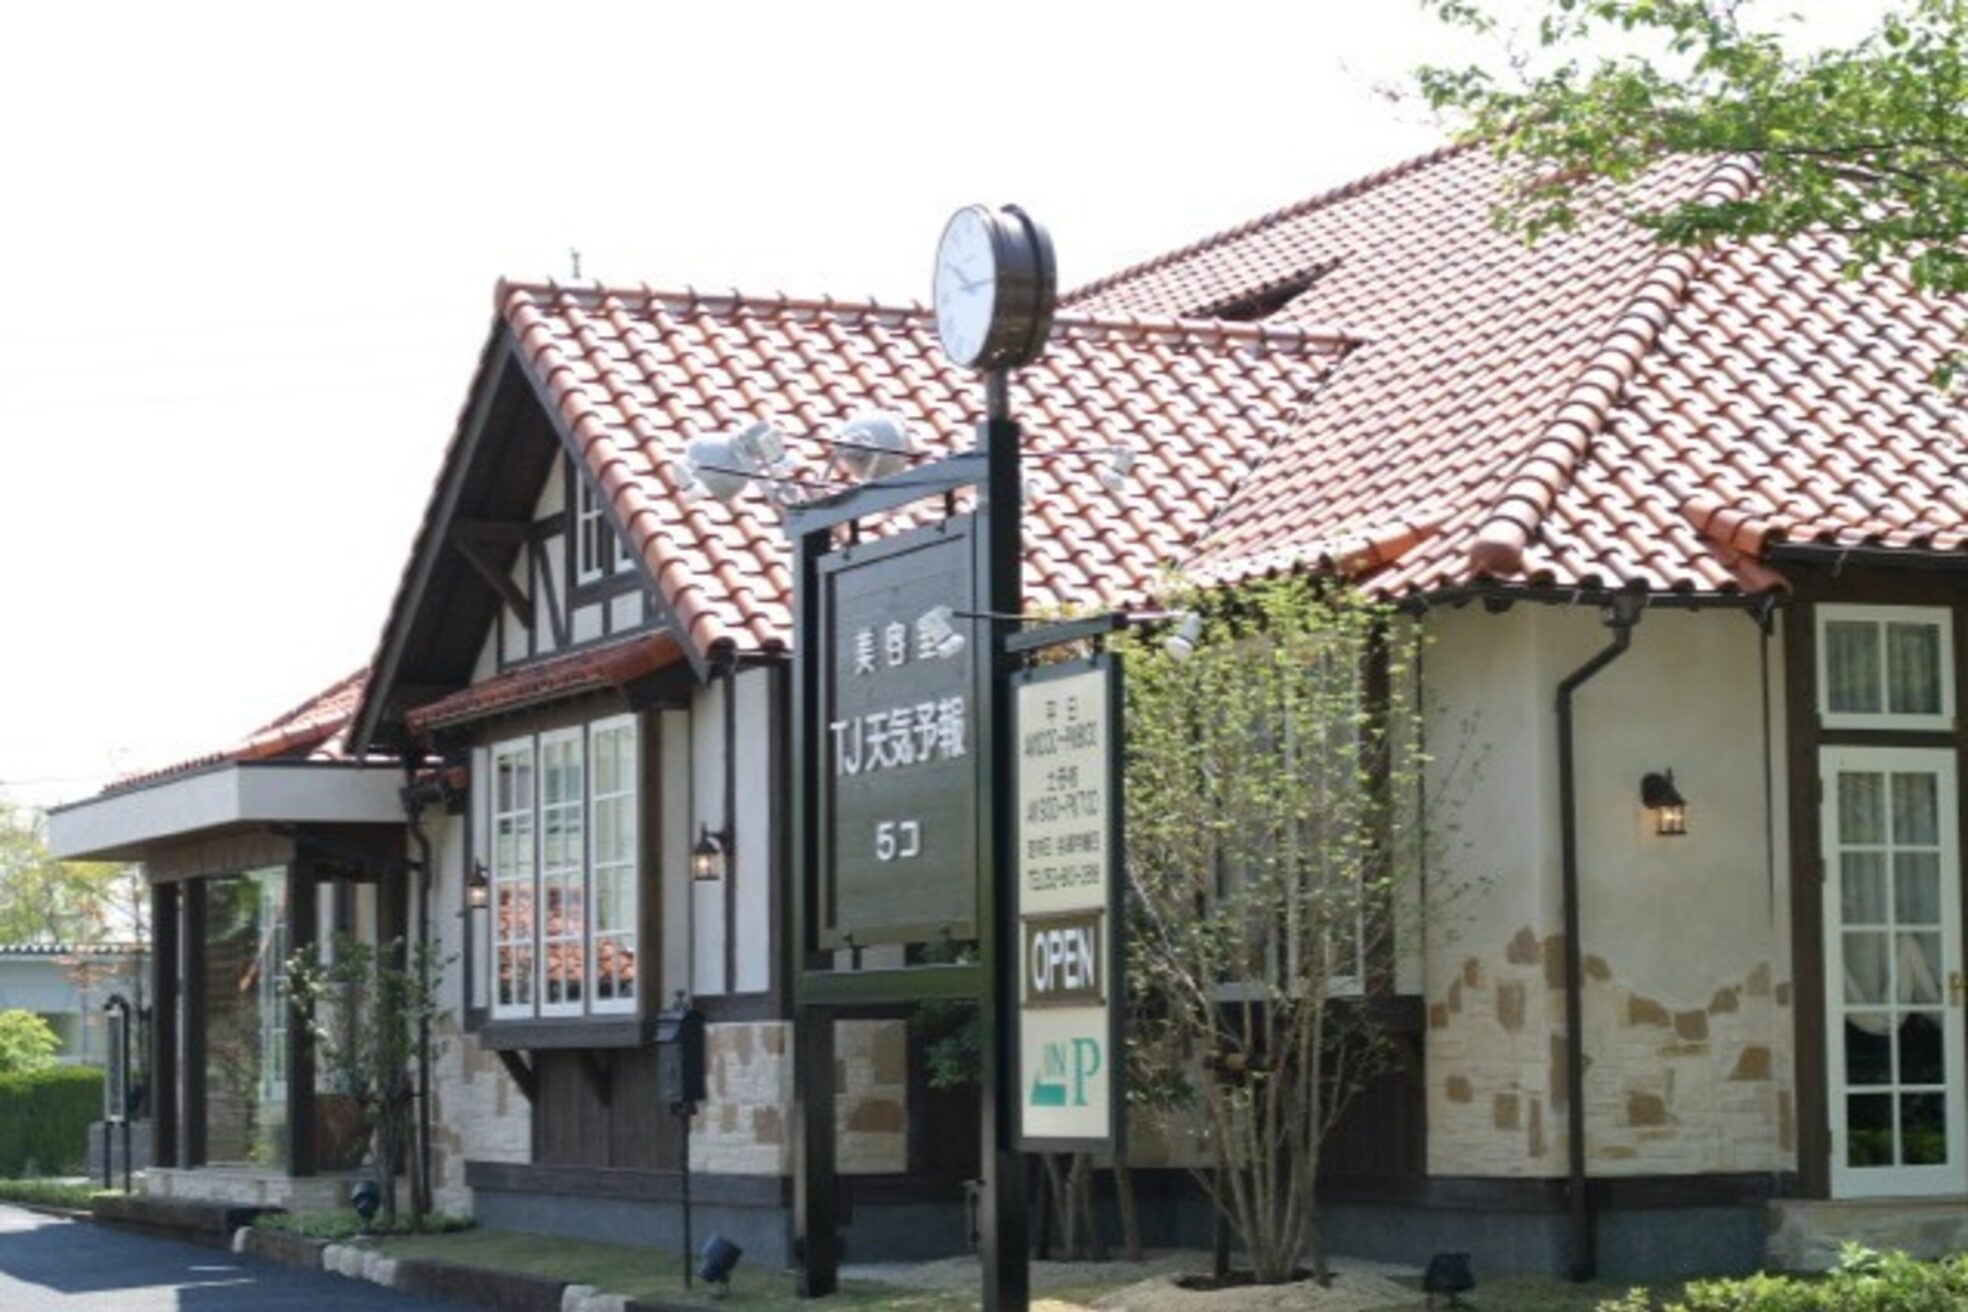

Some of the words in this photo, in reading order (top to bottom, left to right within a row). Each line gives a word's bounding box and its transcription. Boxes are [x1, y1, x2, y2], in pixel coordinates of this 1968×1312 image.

[830, 696, 965, 776] TJ天気予報
[1032, 927, 1094, 992] OPEN
[1071, 1037, 1101, 1106] P
